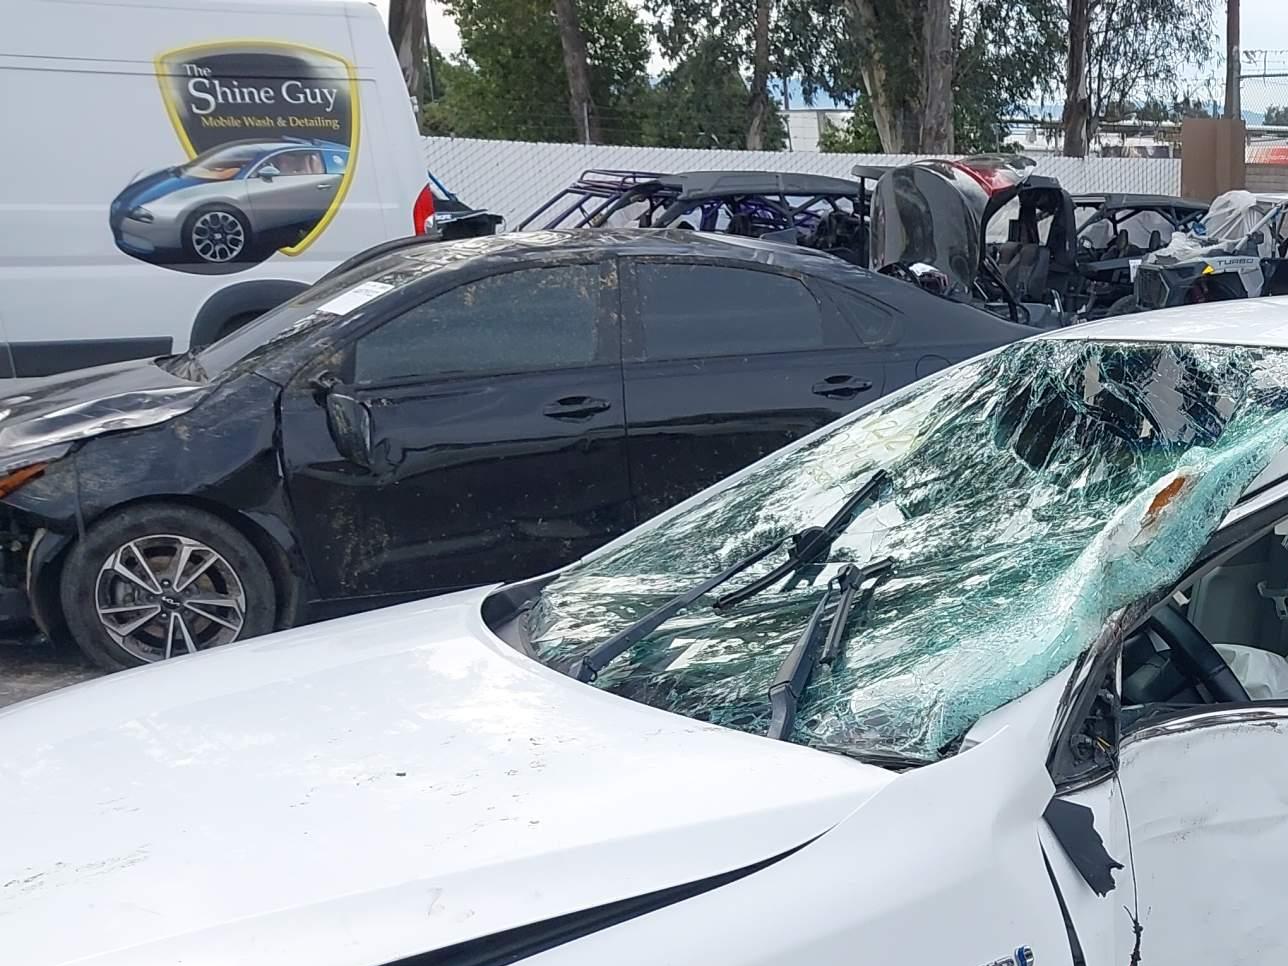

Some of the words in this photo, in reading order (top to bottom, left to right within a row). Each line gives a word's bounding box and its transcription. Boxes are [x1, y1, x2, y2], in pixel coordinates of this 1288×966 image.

[183, 63, 212, 77] The
[187, 77, 275, 114] Shine
[281, 80, 338, 112] Guy
[200, 115, 241, 128] Mobile
[242, 115, 274, 128] Wash
[276, 116, 288, 127] &
[288, 115, 340, 130] Detailing
